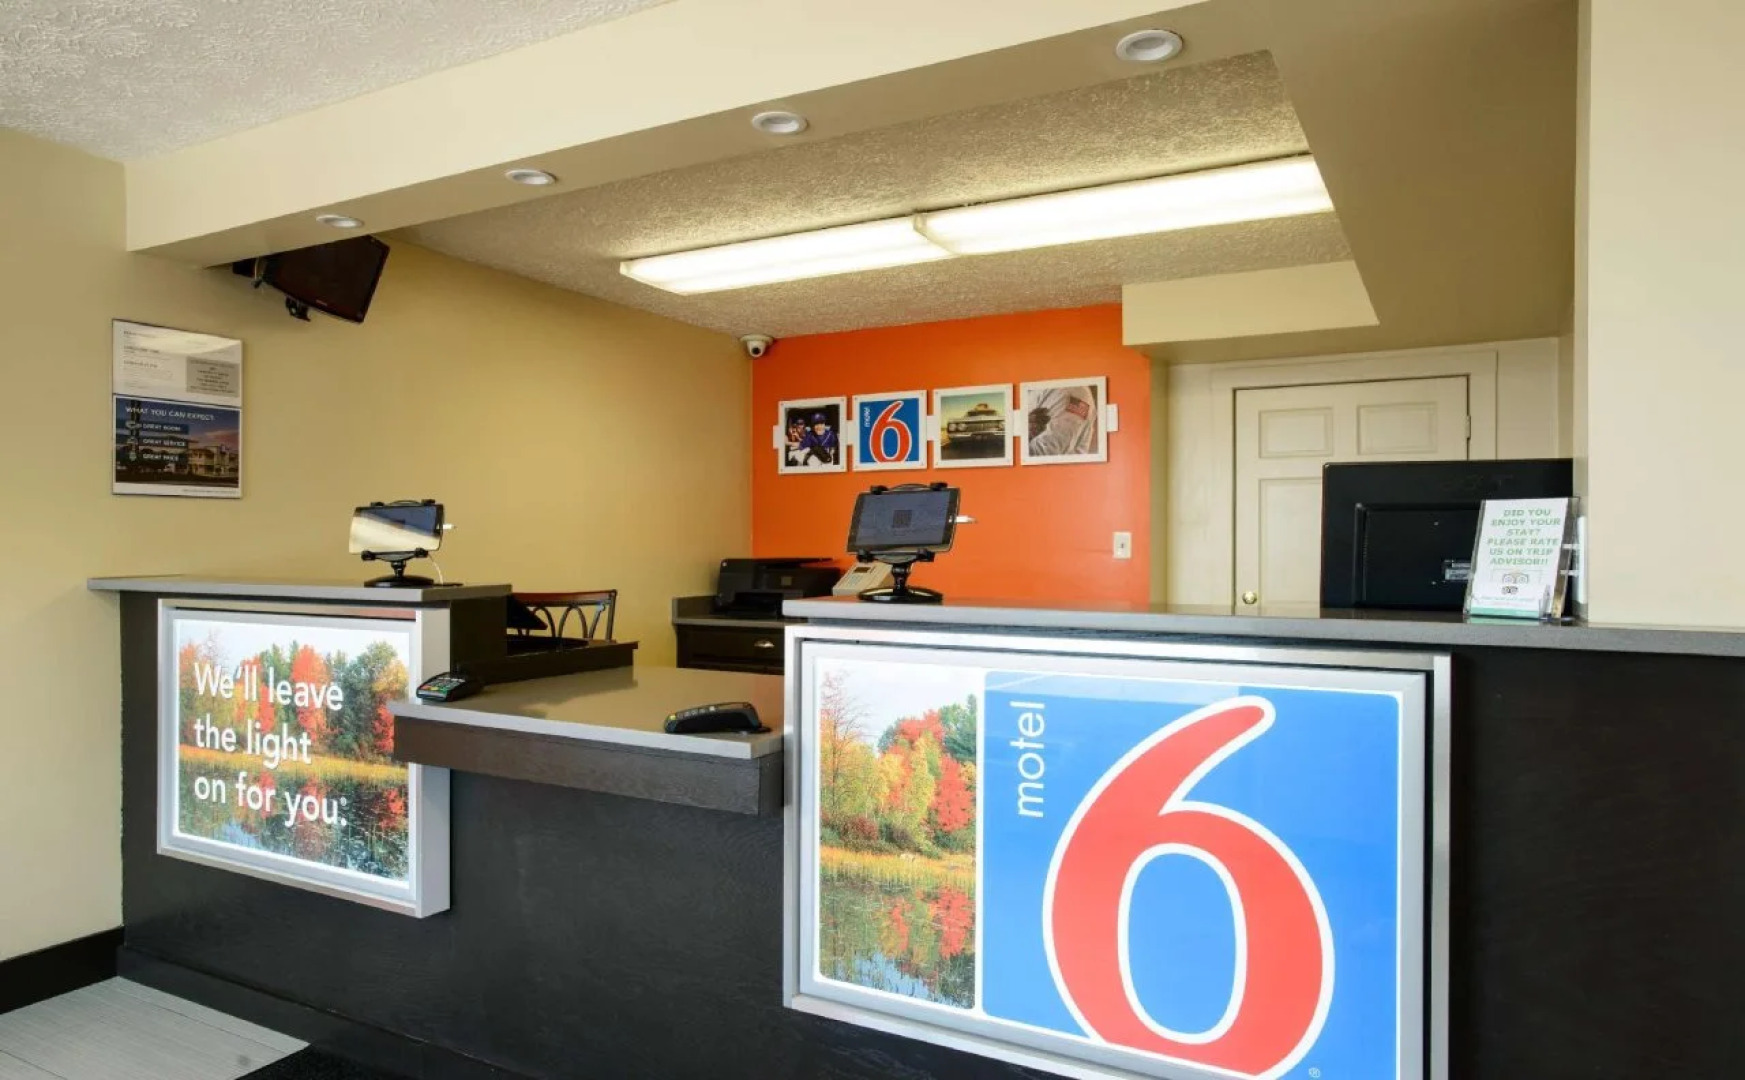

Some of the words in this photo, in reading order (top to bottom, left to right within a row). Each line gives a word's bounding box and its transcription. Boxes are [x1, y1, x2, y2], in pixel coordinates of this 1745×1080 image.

[125, 406, 148, 414] WHAT
[151, 409, 167, 417] YOU
[168, 410, 186, 419] CAN
[869, 400, 912, 463] 6
[1487, 538, 1527, 546] PLEASE
[1530, 538, 1560, 546] RATE
[1490, 518, 1526, 526] ENJOY
[1530, 517, 1561, 526] YOUR
[1489, 547, 1503, 556] US
[1507, 547, 1523, 556] ON
[1526, 547, 1554, 556] TRIP
[194, 662, 258, 702] We'll
[268, 666, 344, 711] leave
[194, 713, 237, 753] the
[246, 719, 312, 770] light
[194, 775, 226, 804] on
[235, 771, 276, 812] for
[1009, 700, 1046, 819] motel
[1042, 694, 1336, 1080] 6
